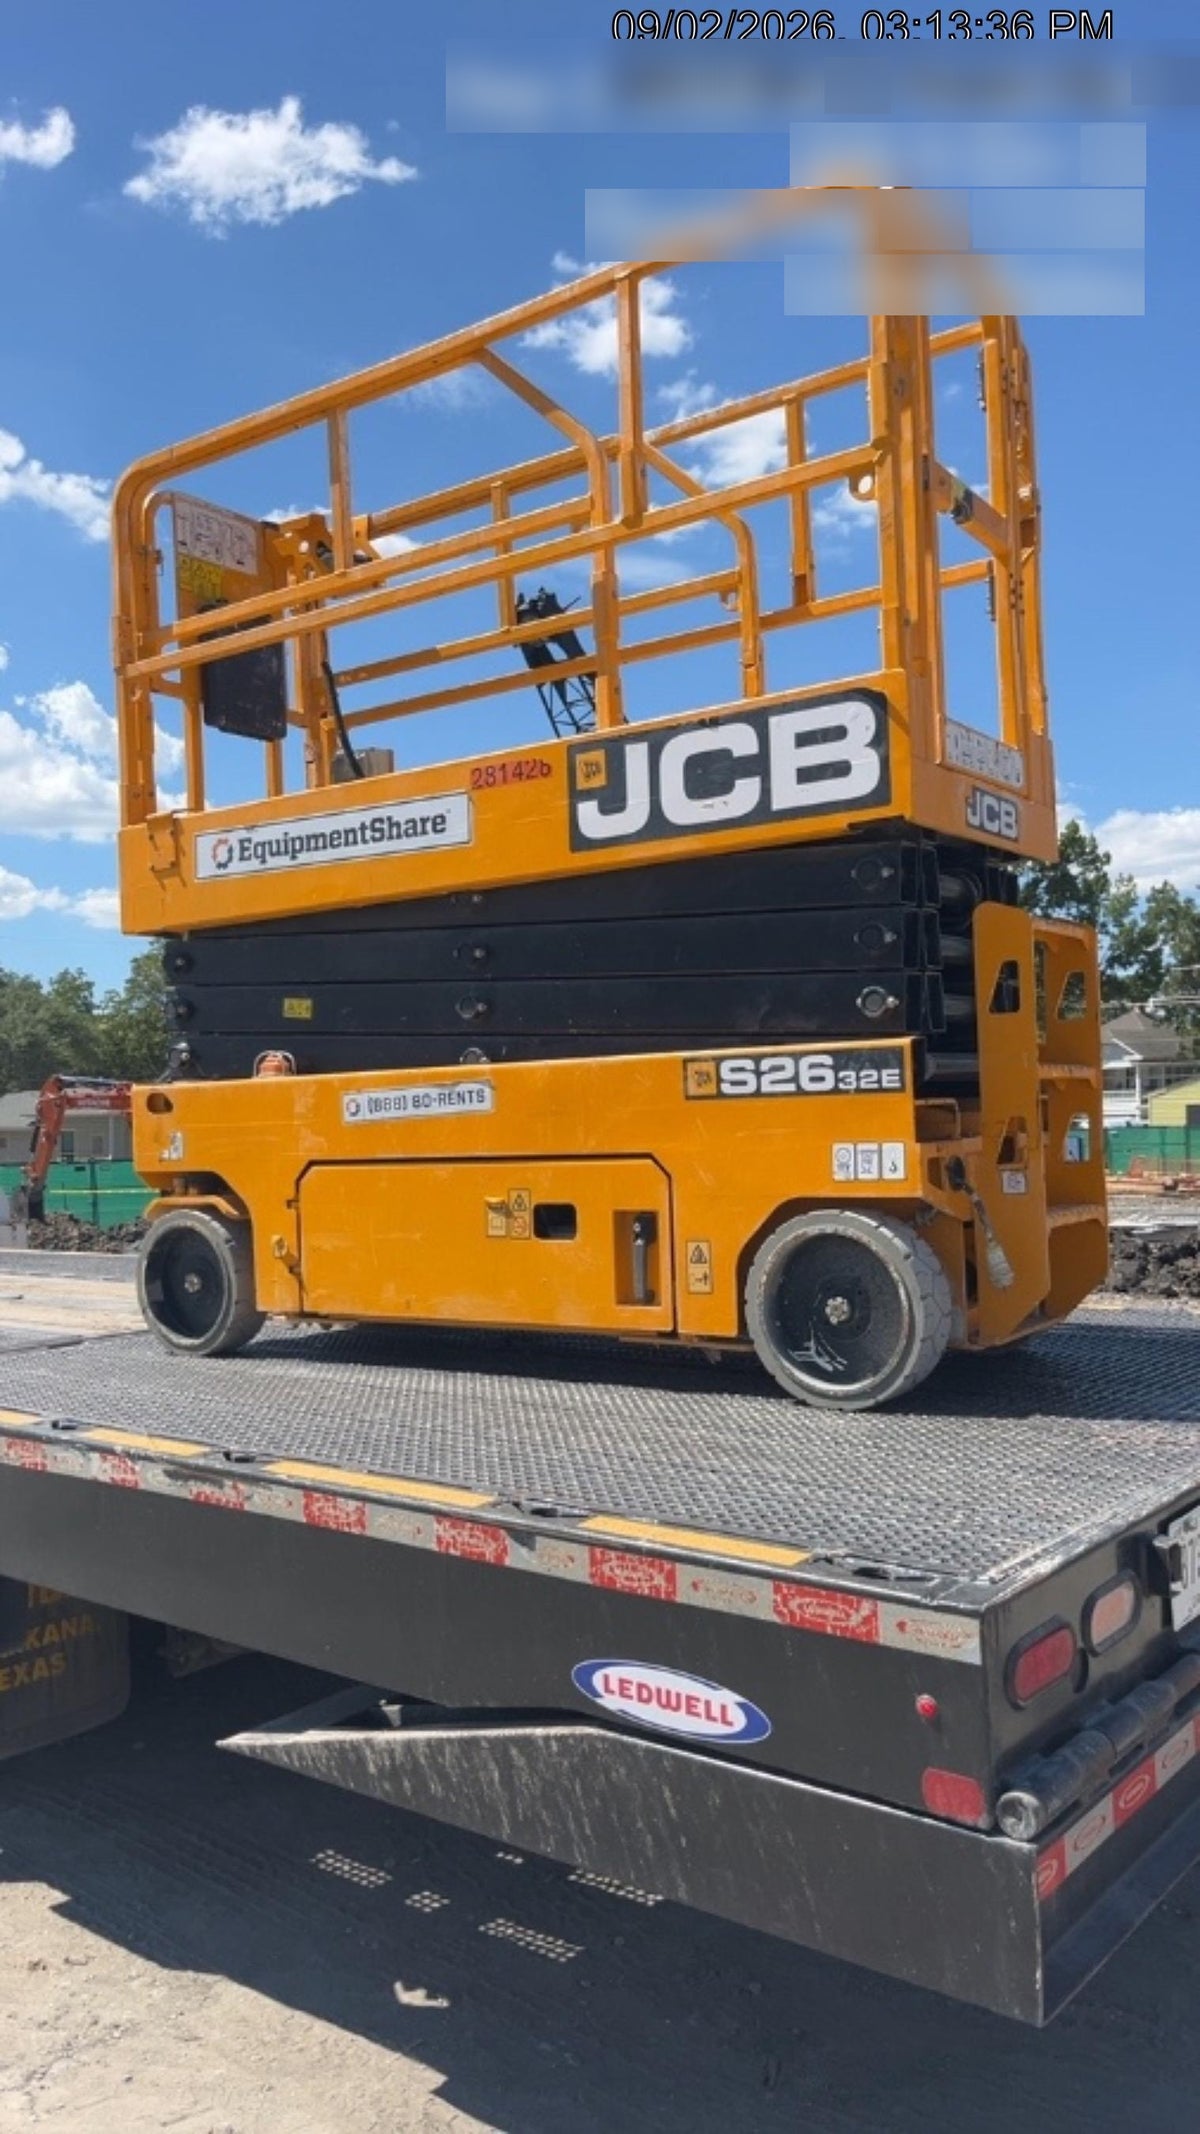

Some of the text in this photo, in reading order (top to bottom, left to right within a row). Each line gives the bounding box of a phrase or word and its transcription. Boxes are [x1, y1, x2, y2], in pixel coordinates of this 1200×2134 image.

[576, 701, 881, 840] JCB
[238, 812, 447, 865] EquipmentShare
[966, 789, 1019, 839] JCB
[602, 1673, 734, 1727] LEDWELL
